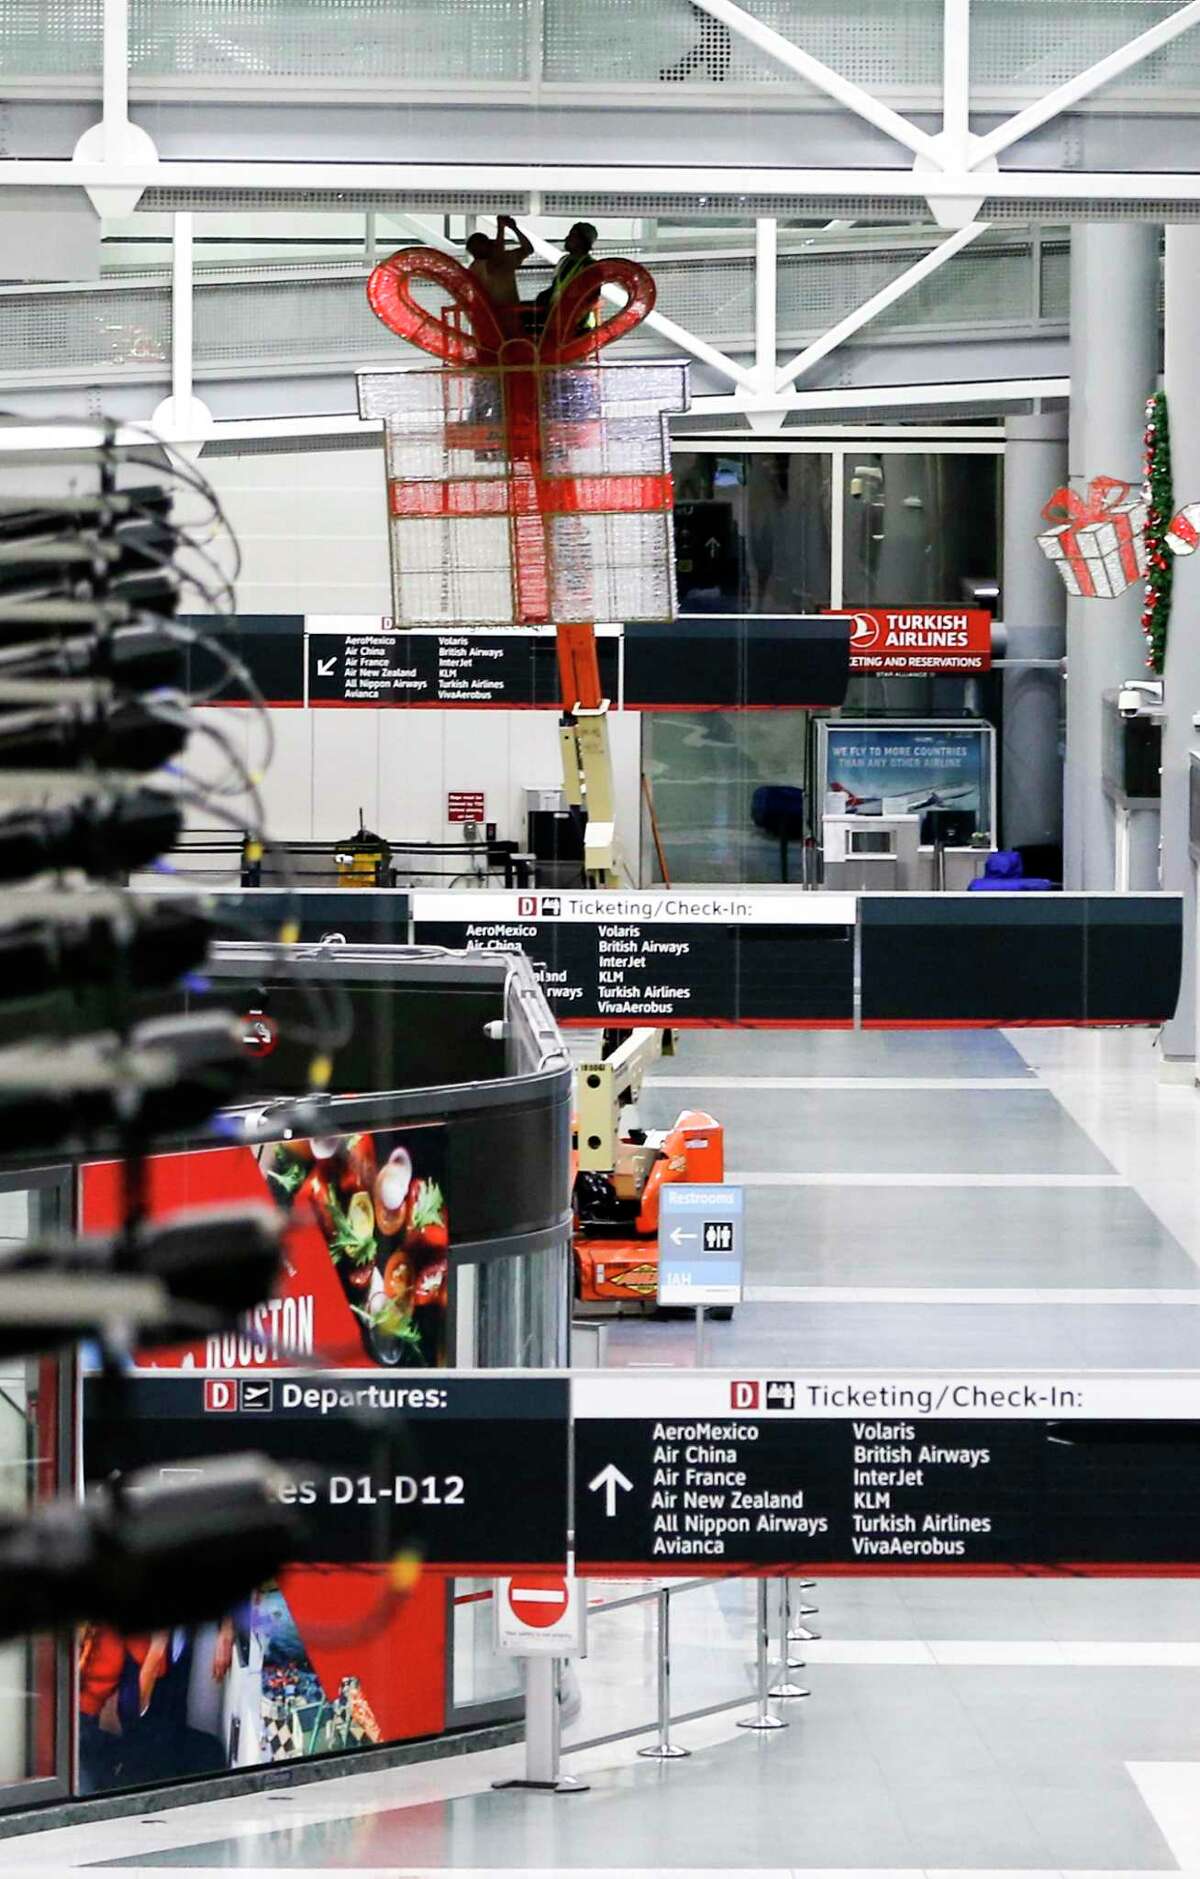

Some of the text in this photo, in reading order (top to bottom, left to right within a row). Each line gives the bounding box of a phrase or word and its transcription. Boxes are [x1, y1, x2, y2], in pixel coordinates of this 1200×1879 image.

[886, 615, 967, 629] TURKISH
[345, 637, 395, 645] AeroMexico
[438, 637, 468, 646] Volaris
[886, 632, 968, 646] AIRLINES
[345, 647, 385, 655] Air China
[439, 648, 504, 658] British Airways
[345, 658, 389, 666] Air France
[439, 659, 472, 667] InterJet
[884, 657, 906, 666] AND
[909, 658, 981, 667] RESERVATIONS
[344, 669, 416, 677] Air New Zealand
[439, 669, 457, 678] KLM
[345, 680, 427, 689] All Nippon Airways
[439, 680, 504, 689] Turkish Airlines
[345, 690, 378, 698] Avianca
[438, 691, 491, 700] VivaAerobus
[521, 900, 753, 919] D Ticketing/Check-In:
[467, 925, 537, 936] AeroMexico
[598, 925, 640, 937] Volaris
[467, 940, 522, 950] Air China
[599, 941, 689, 955] British Airways
[600, 956, 646, 968] InterJet
[600, 971, 623, 983] KLM
[548, 986, 583, 999] rways
[598, 987, 690, 998] Turkish Airlines
[598, 1002, 673, 1014] VivaAerobus
[213, 1384, 448, 1413] D Departures:
[737, 1386, 1084, 1412] D Ticketing/Check-In:
[653, 1424, 758, 1440] AeroMexico
[853, 1423, 915, 1440] Volaris
[653, 1446, 737, 1463] Air China
[854, 1446, 990, 1467] British Airways
[653, 1470, 746, 1486] Air France
[854, 1470, 923, 1486] InterJet
[330, 1476, 465, 1504] D1-D12
[652, 1492, 803, 1509] Air New Zealand
[854, 1493, 890, 1509] KLM
[653, 1515, 828, 1535] All Nippon Airways
[853, 1515, 991, 1532] Turkish Airlines
[653, 1538, 724, 1554] Avianca
[852, 1538, 965, 1554] VivaAerobus
